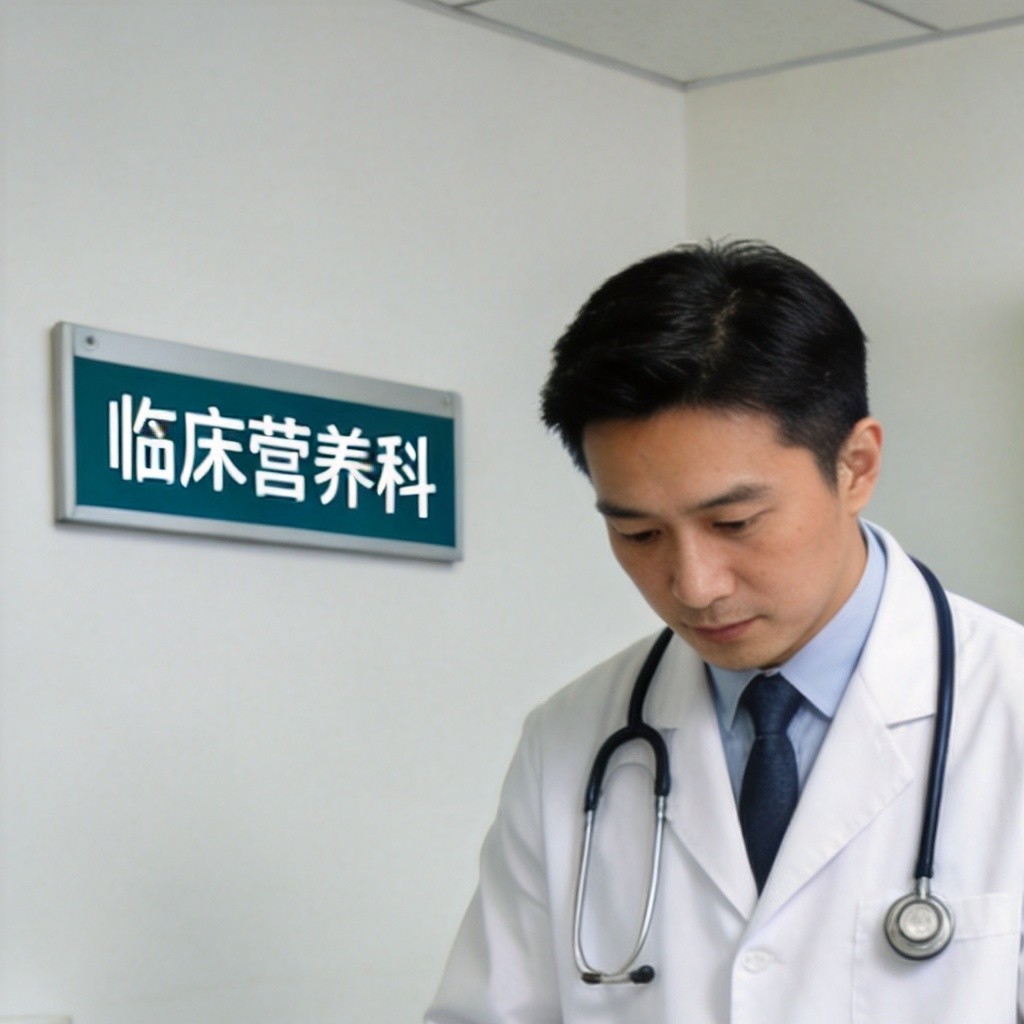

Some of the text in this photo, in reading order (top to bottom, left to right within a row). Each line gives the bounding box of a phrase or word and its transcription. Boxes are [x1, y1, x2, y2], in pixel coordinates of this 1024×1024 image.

[109, 393, 437, 519] 临床营养科
